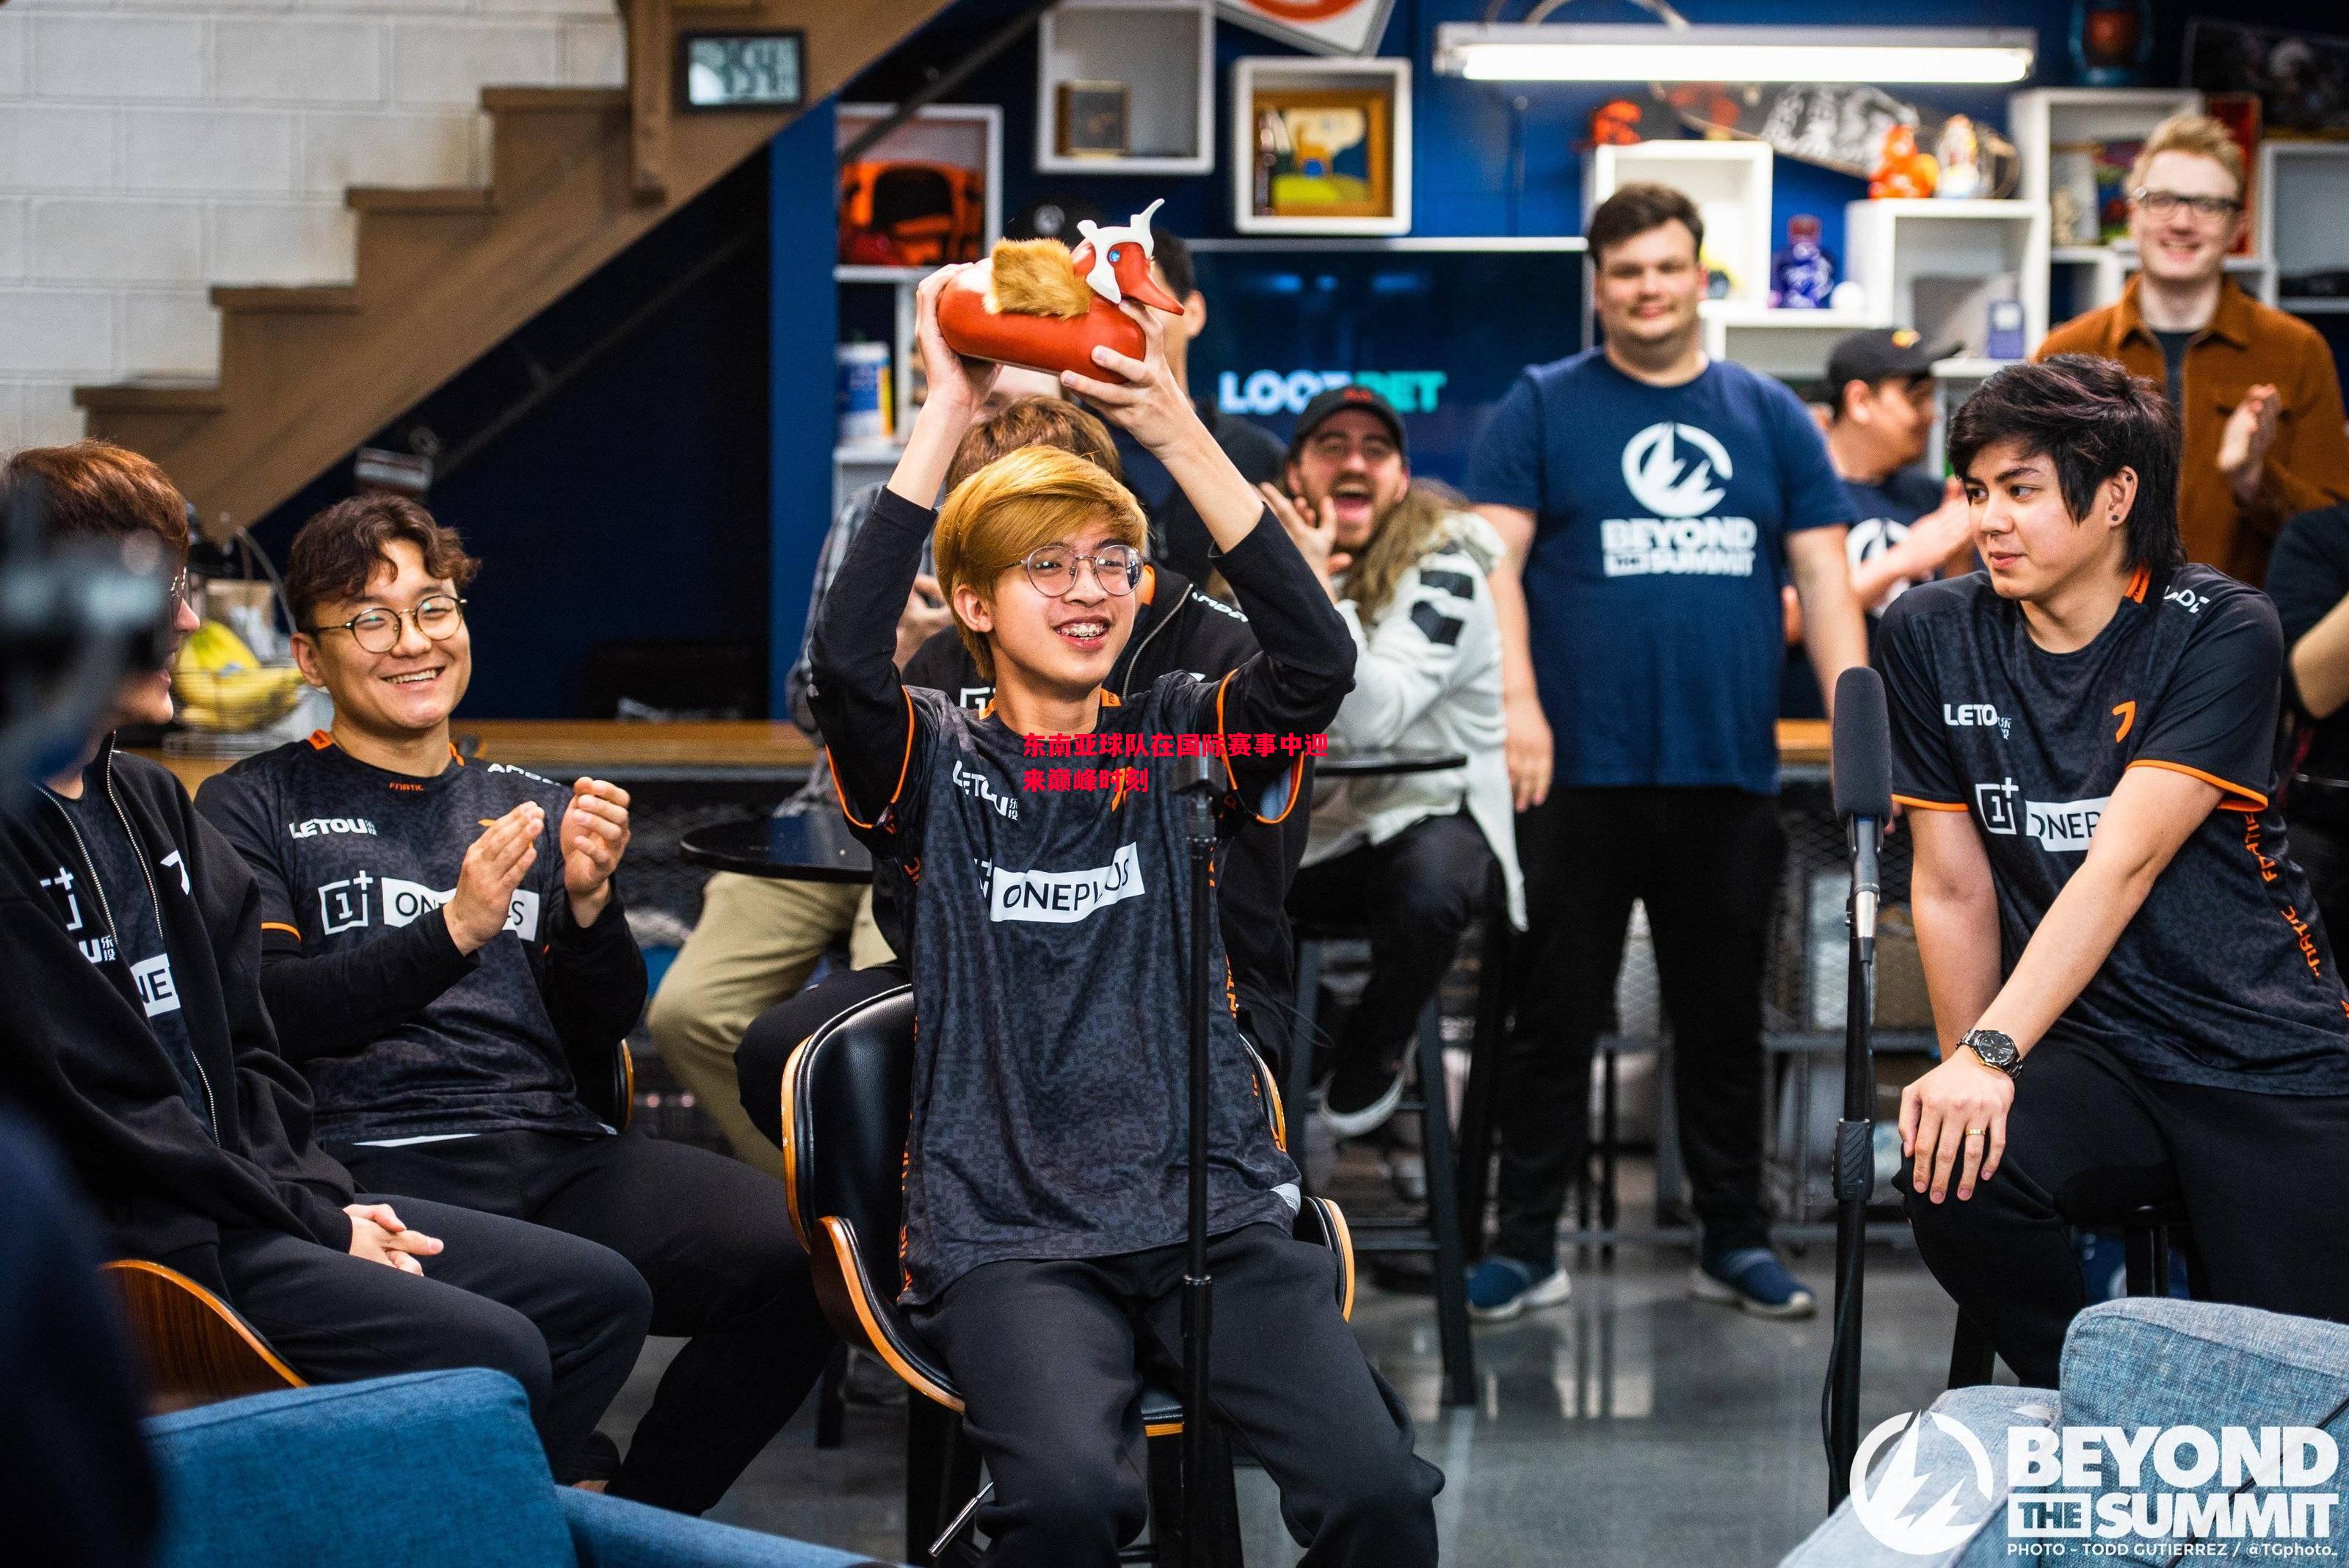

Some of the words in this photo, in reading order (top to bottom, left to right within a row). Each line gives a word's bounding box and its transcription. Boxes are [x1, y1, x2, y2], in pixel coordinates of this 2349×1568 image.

[1600, 516, 1757, 549] BEYOND
[1651, 549, 1755, 576] SUMMIT
[1944, 703, 2003, 728] LETO
[288, 819, 368, 839] LETOU
